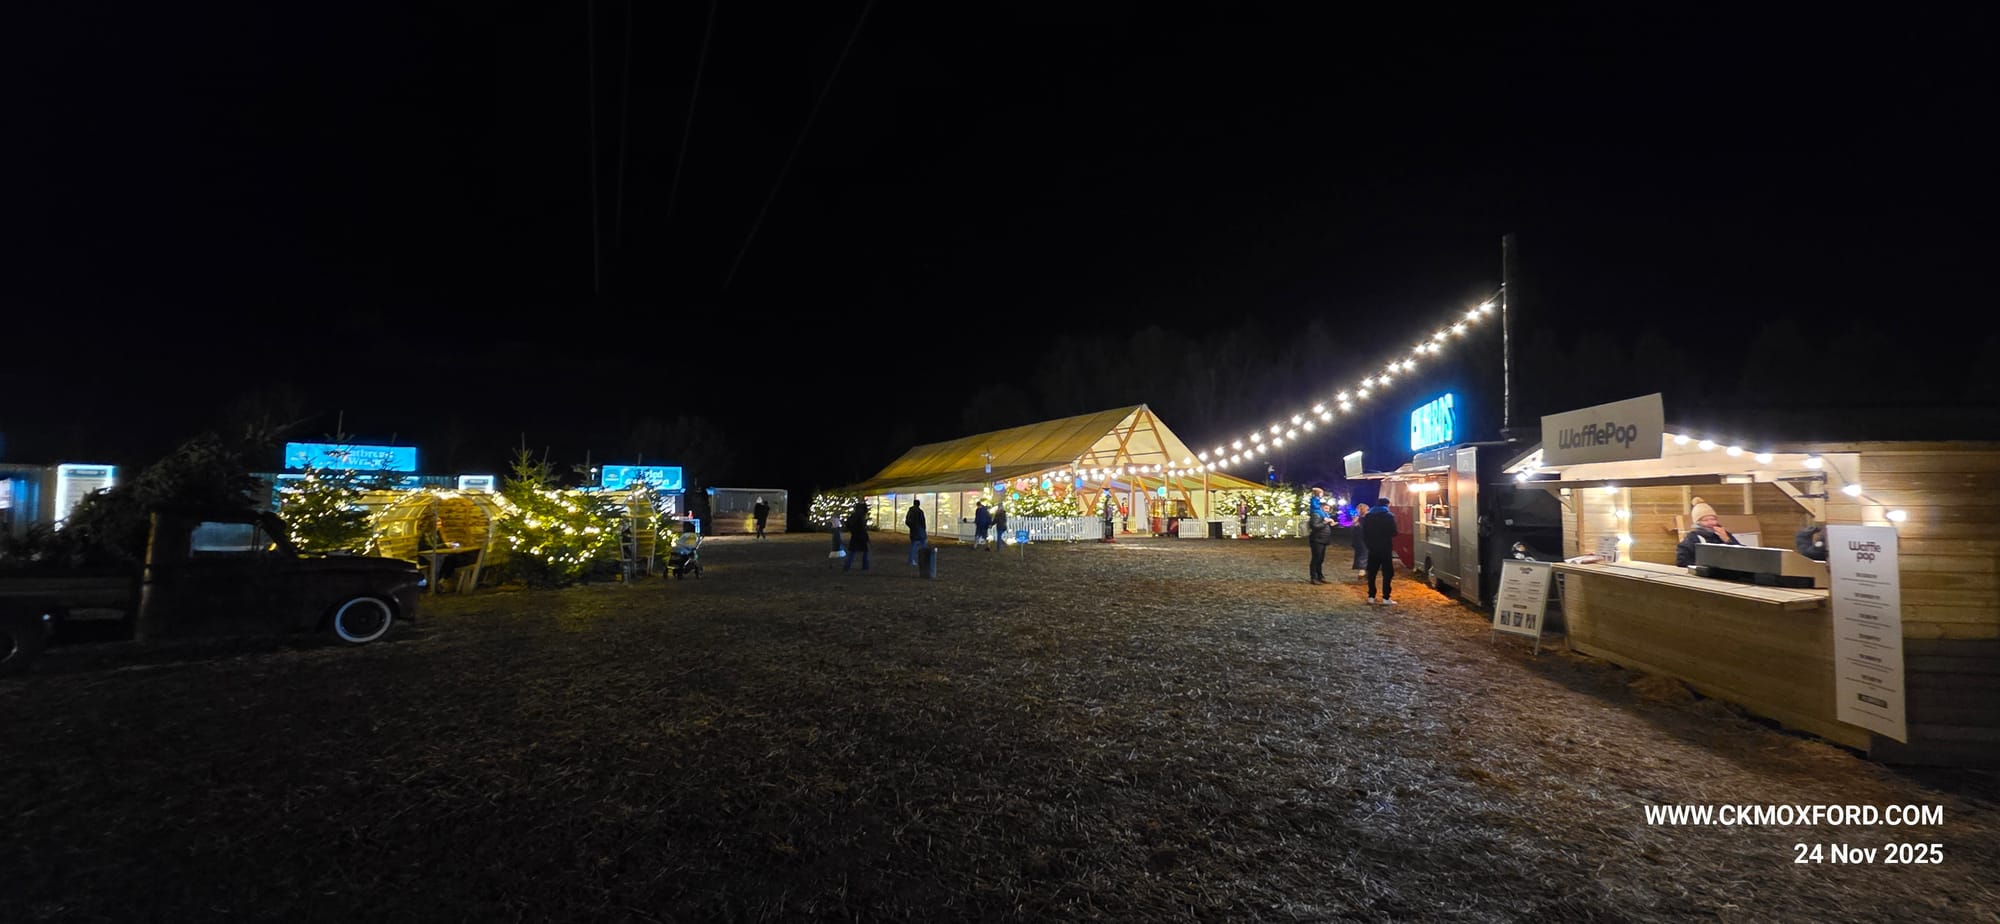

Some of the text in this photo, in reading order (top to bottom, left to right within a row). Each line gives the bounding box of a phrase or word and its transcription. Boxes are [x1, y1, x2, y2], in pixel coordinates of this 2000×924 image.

[1558, 422, 1637, 450] WafflePop
[1848, 540, 1882, 553] Waffle
[1856, 551, 1875, 563] pop
